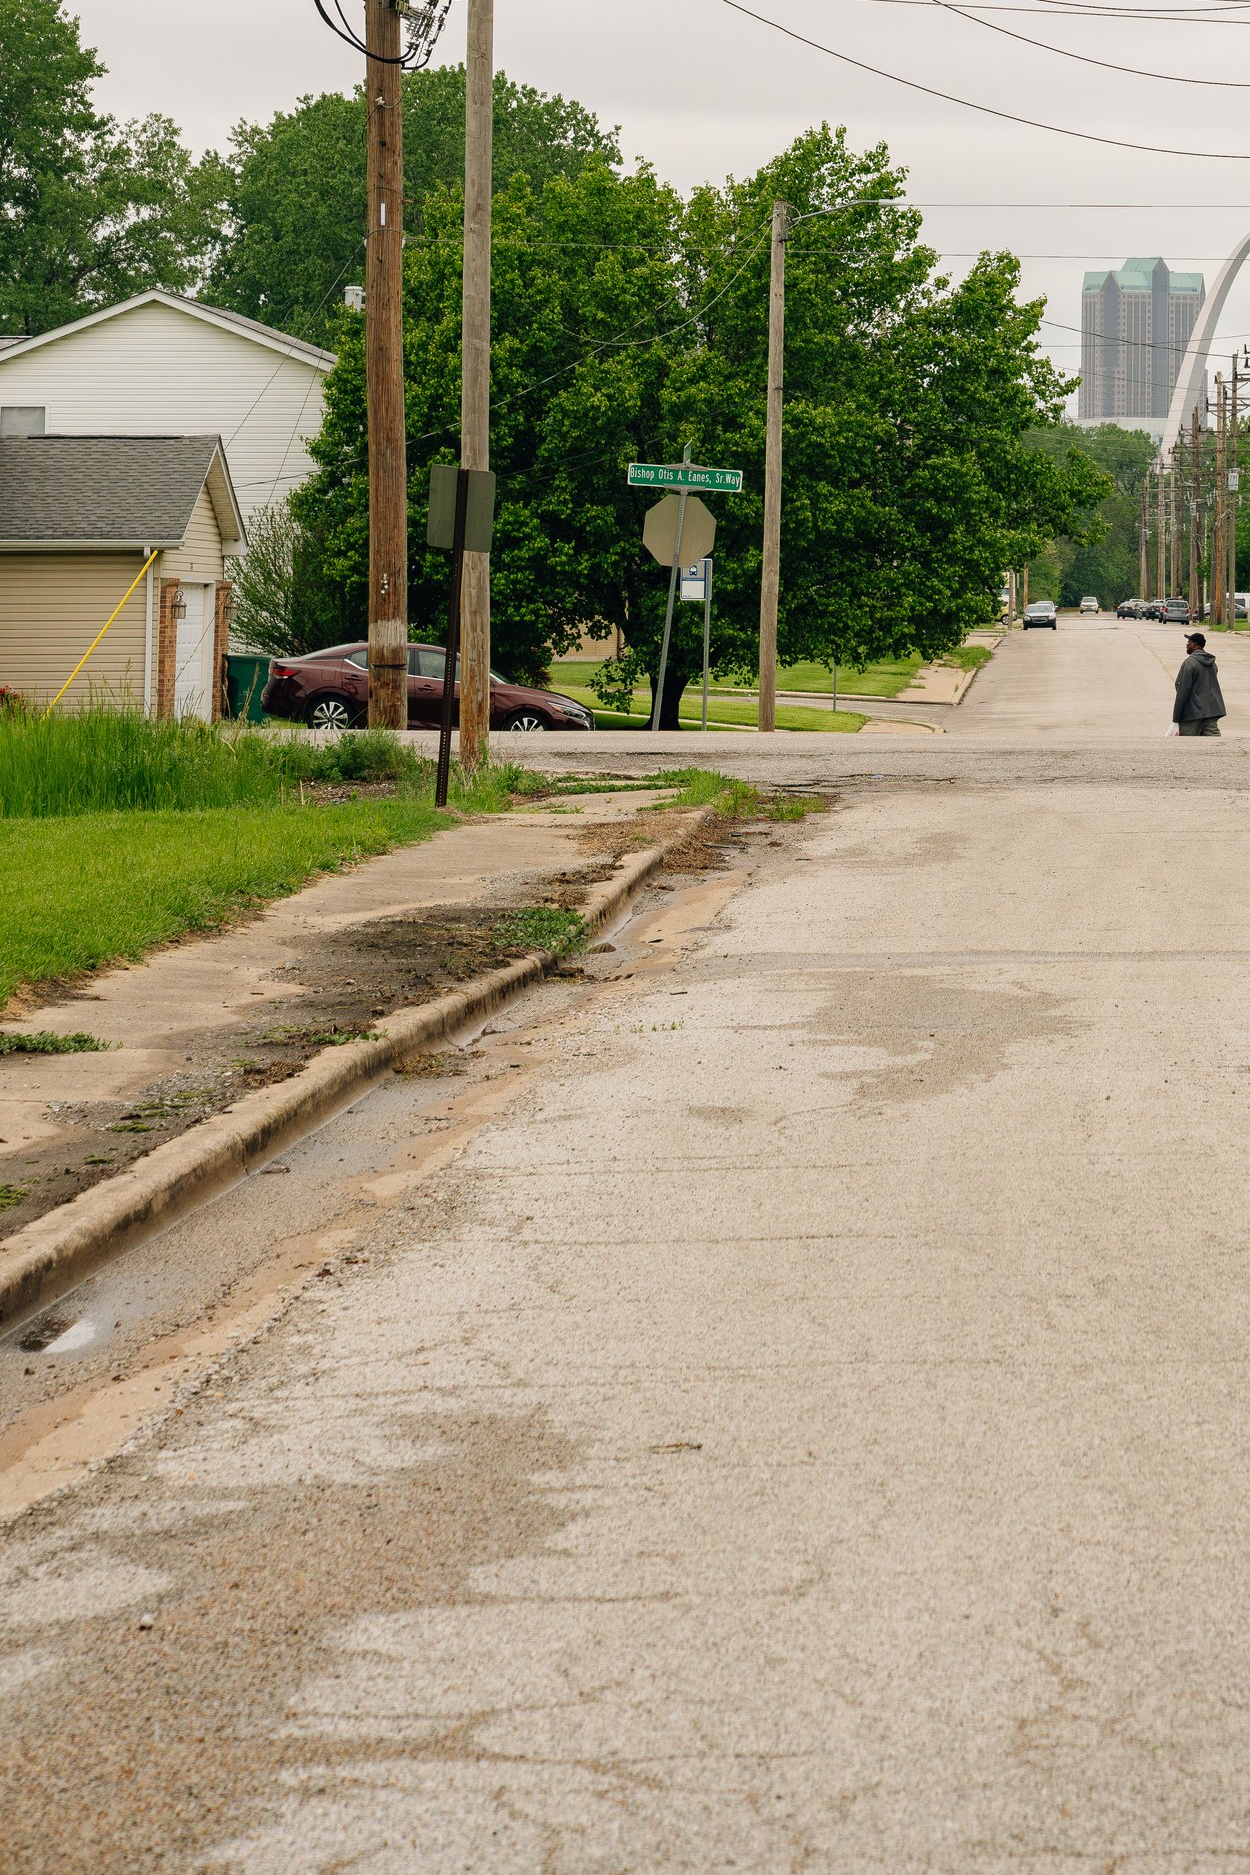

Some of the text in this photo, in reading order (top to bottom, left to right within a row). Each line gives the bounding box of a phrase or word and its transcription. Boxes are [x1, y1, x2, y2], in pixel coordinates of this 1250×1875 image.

[630, 467, 655, 481] Bishop
[658, 469, 674, 480] Otis
[677, 469, 685, 481] A.
[688, 471, 712, 484] Eanes,
